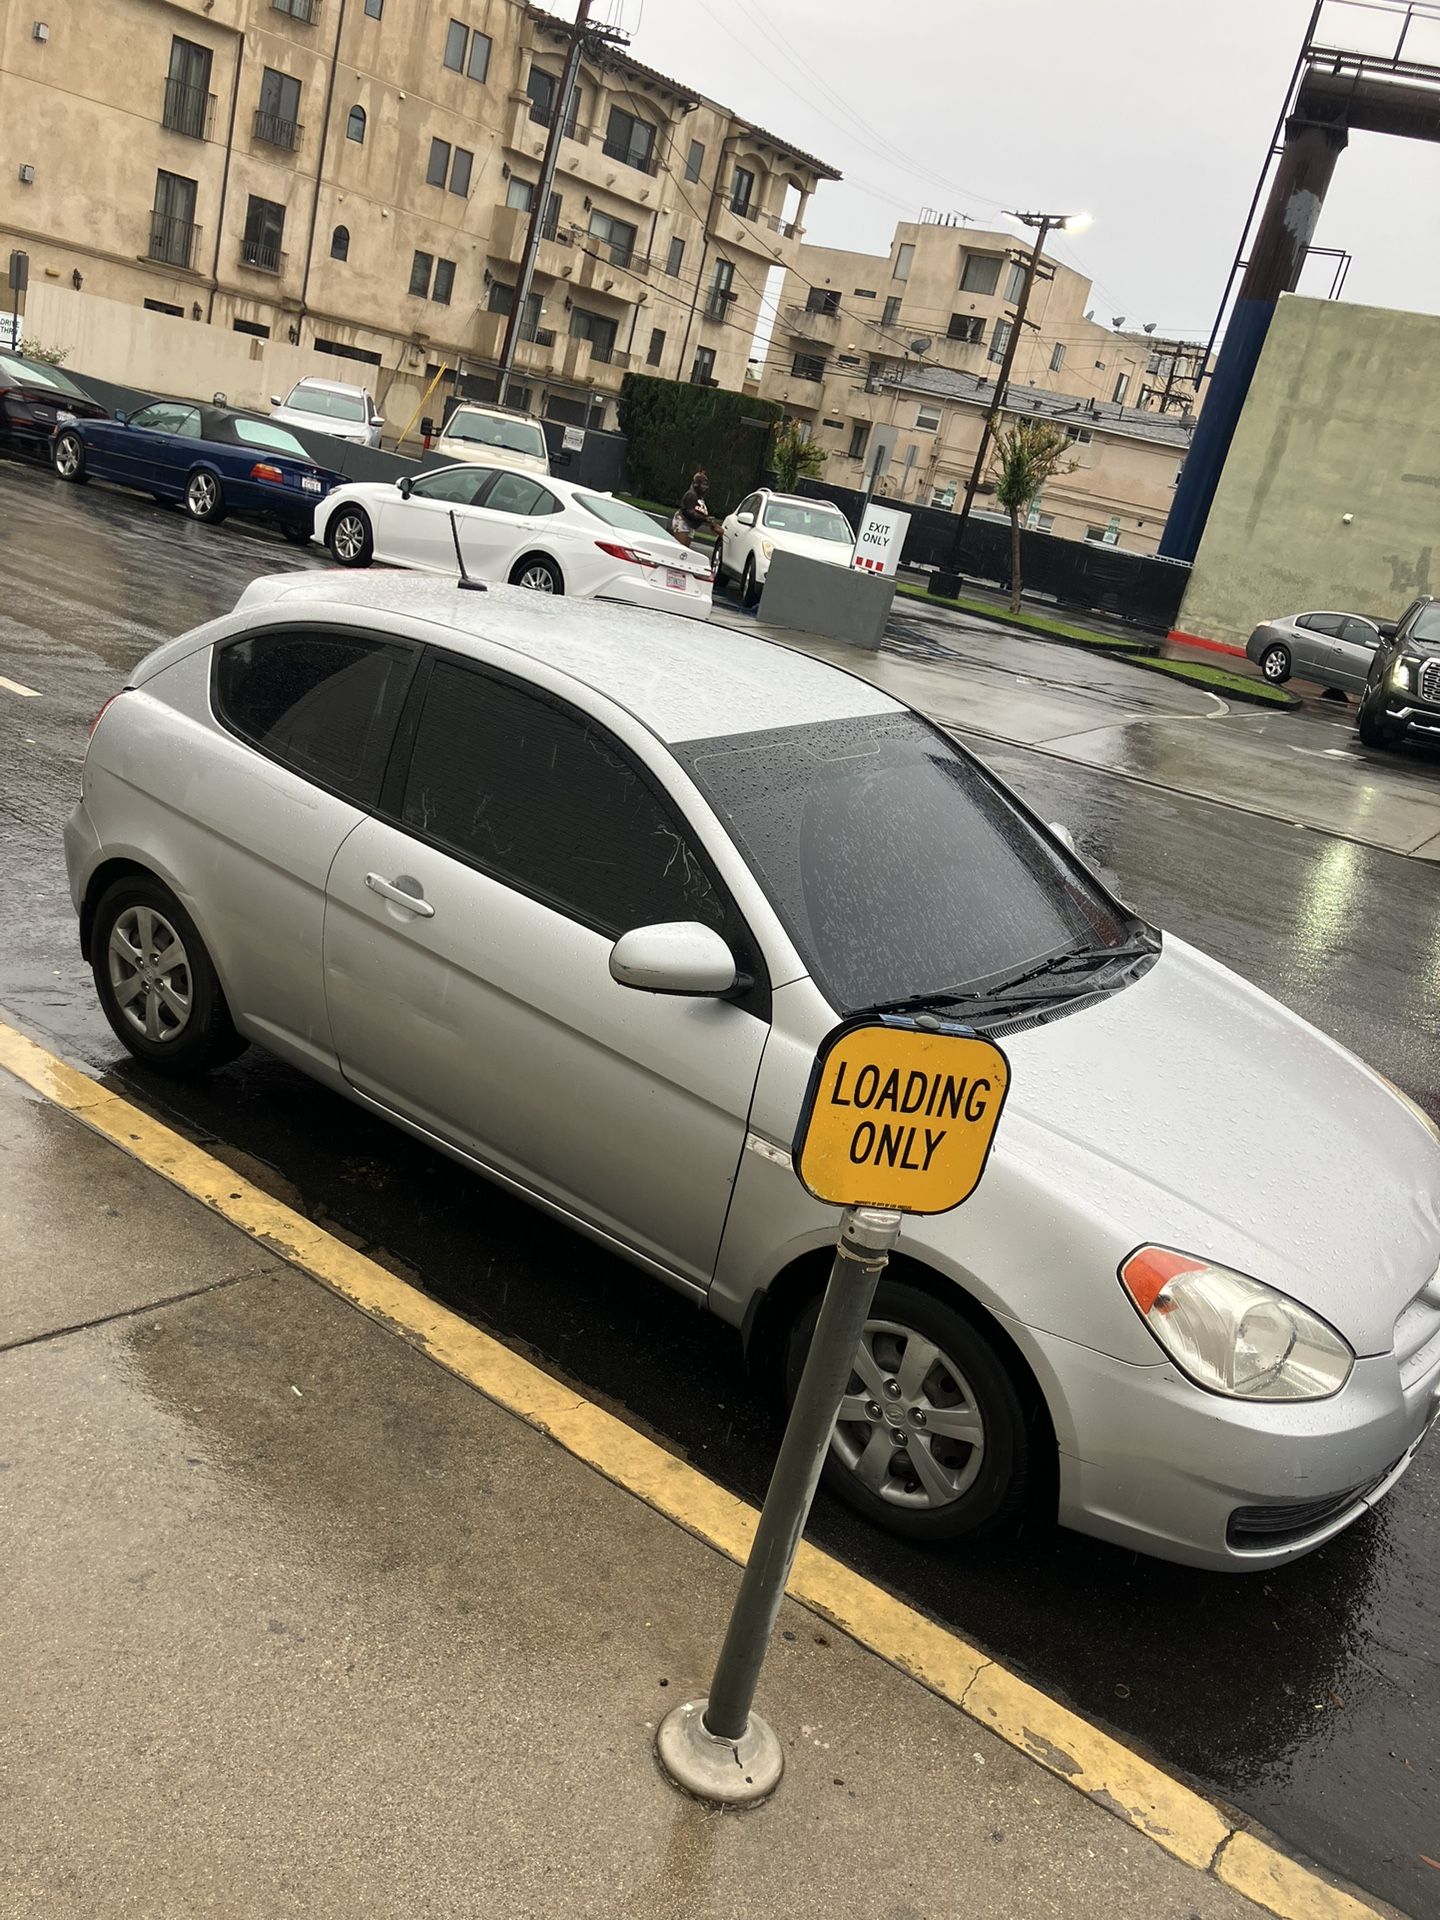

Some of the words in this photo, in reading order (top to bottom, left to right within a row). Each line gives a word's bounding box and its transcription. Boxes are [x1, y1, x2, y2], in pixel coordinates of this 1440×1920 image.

[1, 326, 18, 335] THR
[869, 522, 890, 535] EXIT
[863, 532, 890, 547] ONLY
[831, 1062, 990, 1122] LOADING
[850, 1121, 947, 1171] ONLY
